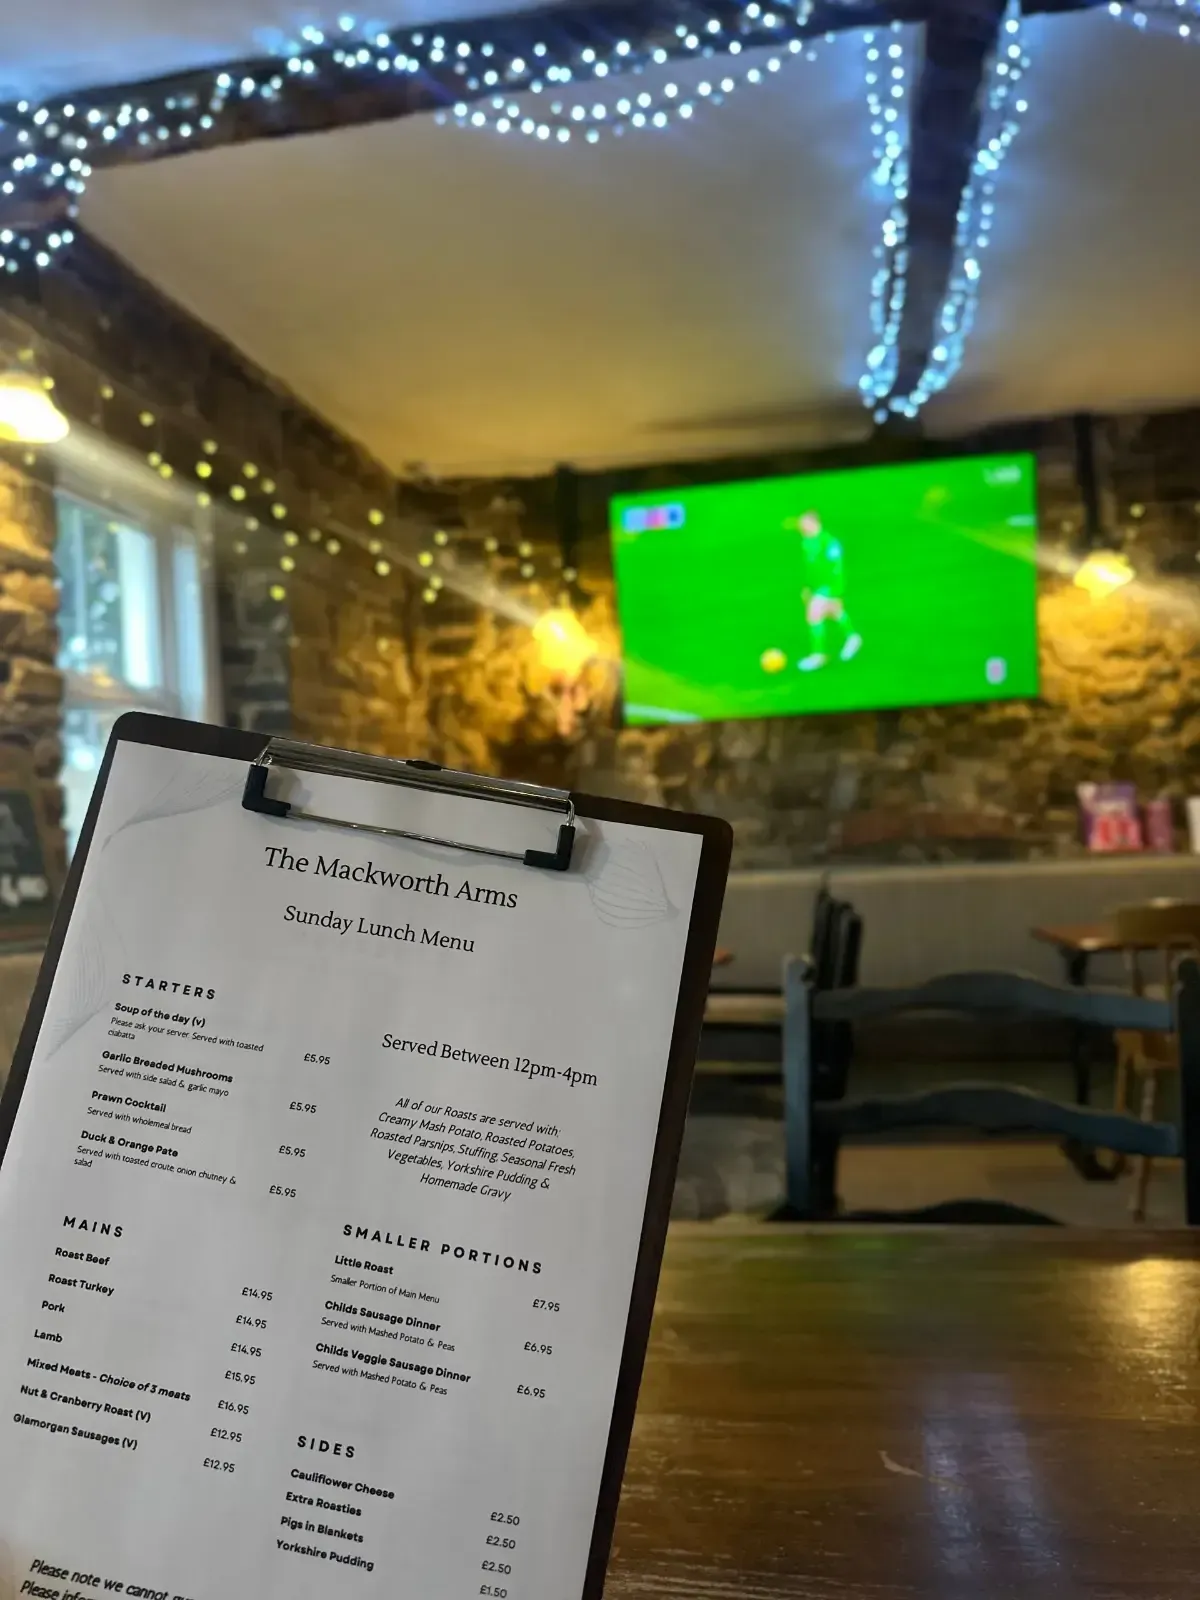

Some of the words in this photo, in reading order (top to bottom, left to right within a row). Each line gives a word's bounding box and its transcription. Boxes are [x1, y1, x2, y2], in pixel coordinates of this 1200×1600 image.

[265, 846, 309, 873] The
[313, 855, 449, 897] Mackworth
[453, 880, 518, 908] Arms
[283, 905, 354, 936] Sunday
[356, 917, 416, 943] Lunch
[419, 928, 475, 953] Menu
[122, 973, 216, 1000] STARTERS
[114, 1002, 140, 1016] Soup
[140, 1008, 154, 1017] of
[153, 1010, 171, 1020] the
[171, 1013, 191, 1026] day
[191, 1016, 206, 1029] (v)
[107, 1029, 136, 1040] ciabatta
[110, 1017, 133, 1028] Please
[134, 1022, 147, 1031] ask
[147, 1025, 165, 1034] your
[191, 1032, 218, 1044] Served
[219, 1038, 235, 1047] with
[236, 1041, 265, 1052] toasted
[102, 1050, 132, 1063] Garlic
[132, 1056, 176, 1072] Breaded
[175, 1064, 233, 1083] Mushrooms
[303, 1053, 331, 1065] £5.95
[382, 1033, 438, 1057] Served
[439, 1043, 510, 1070] Between
[513, 1057, 597, 1088] 12pm-4pm
[98, 1064, 125, 1077] Served
[125, 1071, 142, 1080] with
[142, 1074, 158, 1083] side
[158, 1077, 178, 1087] salad
[178, 1079, 185, 1088] &
[187, 1083, 208, 1093] garlic
[208, 1087, 229, 1097] mayo
[91, 1090, 123, 1105] Prawn
[124, 1097, 167, 1113] Cocktail
[289, 1101, 317, 1114] £5.95
[395, 1097, 410, 1109] All
[410, 1100, 425, 1111] of
[424, 1105, 443, 1114] our
[443, 1106, 478, 1121] Roasts
[479, 1115, 497, 1125] are
[497, 1118, 535, 1132] served
[87, 1106, 114, 1119] Served
[114, 1113, 131, 1122] with
[132, 1116, 171, 1130] wholemeal
[170, 1122, 193, 1134] bread
[80, 1130, 107, 1143] Duck
[108, 1135, 115, 1145] &
[117, 1137, 155, 1153] Orange
[155, 1145, 179, 1158] Pate
[378, 1111, 418, 1131] Creamy
[418, 1119, 446, 1133] Mash
[447, 1124, 483, 1142] Potato,
[484, 1131, 528, 1148] Roasted
[528, 1139, 575, 1159] Potatoes,
[73, 1158, 93, 1168] salad
[278, 1145, 306, 1158] £5.95
[370, 1127, 413, 1144] Roasted
[413, 1135, 456, 1154] Parsnips,
[500, 1152, 548, 1170] Seasonal
[547, 1161, 576, 1176] Fresh
[77, 1145, 104, 1158] Served
[105, 1152, 121, 1161] with
[122, 1155, 150, 1167] toasted
[176, 1167, 197, 1176] onion
[198, 1170, 228, 1185] chutney
[229, 1176, 236, 1185] &
[388, 1148, 443, 1170] Vegetables,
[447, 1159, 495, 1179] Yorkshire
[496, 1169, 539, 1190] Pudding
[540, 1177, 550, 1190] &
[269, 1185, 297, 1198] £5.95
[419, 1172, 478, 1193] Homemade
[480, 1184, 512, 1202] Gravy
[62, 1215, 123, 1238] MAINS
[54, 1247, 85, 1261] Roast
[85, 1253, 111, 1266] Beef
[343, 1224, 430, 1252] SMALLER
[440, 1243, 542, 1274] PORTIONS
[334, 1255, 362, 1269] Little
[363, 1260, 394, 1275] Roast
[48, 1273, 78, 1288] Roast
[79, 1279, 115, 1297] Turkey
[241, 1287, 273, 1301] £14.95
[330, 1274, 358, 1287] Smaller
[359, 1279, 387, 1293] Portion
[388, 1286, 398, 1295] of
[398, 1288, 417, 1299] Main
[418, 1291, 440, 1304] Menu
[41, 1300, 65, 1313] Pork
[324, 1300, 358, 1315] Childs
[359, 1307, 404, 1325] Sausage
[405, 1316, 441, 1332] Dinner
[532, 1298, 560, 1312] £7.95
[235, 1314, 267, 1329] £14.95
[321, 1316, 349, 1330] Served
[350, 1324, 367, 1334] with
[368, 1326, 399, 1340] Mashed
[399, 1332, 425, 1345] Potato
[427, 1338, 435, 1347] &
[437, 1340, 455, 1352] Peas
[33, 1329, 63, 1343] Lamb
[523, 1341, 552, 1355] £6.95
[230, 1342, 262, 1357] £14.95
[315, 1342, 349, 1358] Childs
[351, 1349, 388, 1366] Veggie
[388, 1357, 434, 1376] Sausage
[435, 1367, 471, 1383] Dinner
[26, 1357, 59, 1372] Mixed
[59, 1364, 91, 1379] Meats
[99, 1373, 136, 1389] Choice
[136, 1382, 151, 1392] of
[149, 1384, 158, 1394] 3
[157, 1388, 191, 1402] meats
[224, 1370, 256, 1385] £15.95
[312, 1359, 340, 1373] Served
[341, 1367, 359, 1377] with
[359, 1369, 390, 1384] Mashed
[391, 1376, 417, 1389] Potato
[419, 1381, 427, 1391] &
[429, 1383, 448, 1395] Peas
[20, 1384, 39, 1397] Nut
[40, 1389, 48, 1399] &
[49, 1391, 103, 1413] Cranberry
[103, 1403, 134, 1418] Roast
[135, 1409, 151, 1423] (V)
[516, 1384, 546, 1399] £6.95
[217, 1399, 250, 1415] £16.95
[13, 1413, 70, 1434] Glamorgan
[70, 1426, 120, 1446] Sausages
[121, 1437, 138, 1451] (V)
[210, 1427, 243, 1443] £12.95
[297, 1435, 355, 1458] SIDES
[203, 1457, 236, 1473] £12.95
[290, 1468, 353, 1490] Cauliflower
[354, 1482, 395, 1500] Cheese
[285, 1491, 314, 1506] Extra
[315, 1497, 362, 1517] Roasties
[280, 1515, 303, 1531] Pigs
[304, 1520, 315, 1532] in
[317, 1524, 364, 1543] Blankets
[490, 1511, 520, 1526] £2.50
[276, 1539, 327, 1559] Yorkshire
[329, 1551, 374, 1572] Pudding
[485, 1535, 516, 1550] £2.50
[29, 1559, 70, 1580] Please
[70, 1572, 101, 1588] note
[103, 1578, 124, 1593] we
[125, 1585, 169, 1600] cannot
[481, 1560, 512, 1575] £2.50
[19, 1580, 60, 1600] Please
[479, 1584, 508, 1599] £1.50
